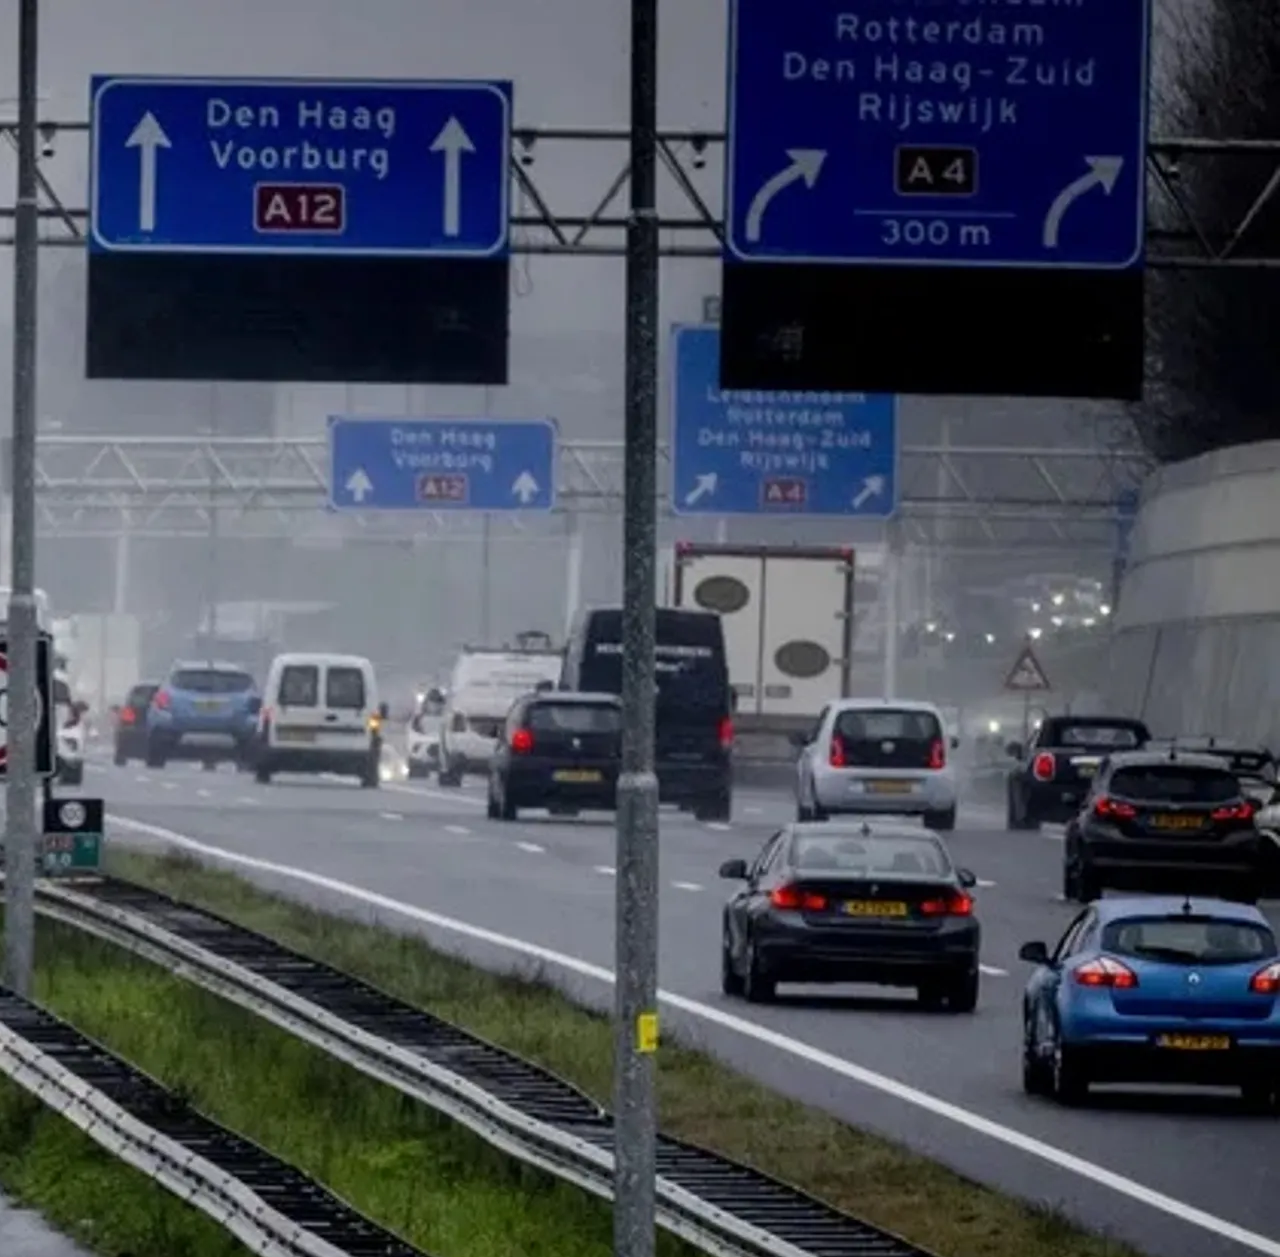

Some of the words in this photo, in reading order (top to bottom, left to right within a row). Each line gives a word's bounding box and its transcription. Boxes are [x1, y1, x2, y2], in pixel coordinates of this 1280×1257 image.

[836, 14, 1044, 45] Rotterdam
[783, 52, 855, 81] Den
[874, 55, 1096, 91] Haag-Zuid
[207, 99, 279, 128] Den
[299, 101, 396, 137] Haag
[859, 94, 1017, 131] Rijswijk
[210, 141, 389, 179] Voorburg
[264, 195, 336, 223] A12
[881, 221, 948, 246] 300
[959, 224, 991, 246] m
[391, 429, 431, 446] Den
[441, 428, 496, 449] Haag
[391, 451, 493, 473] Voorburg
[423, 478, 464, 497] A12
